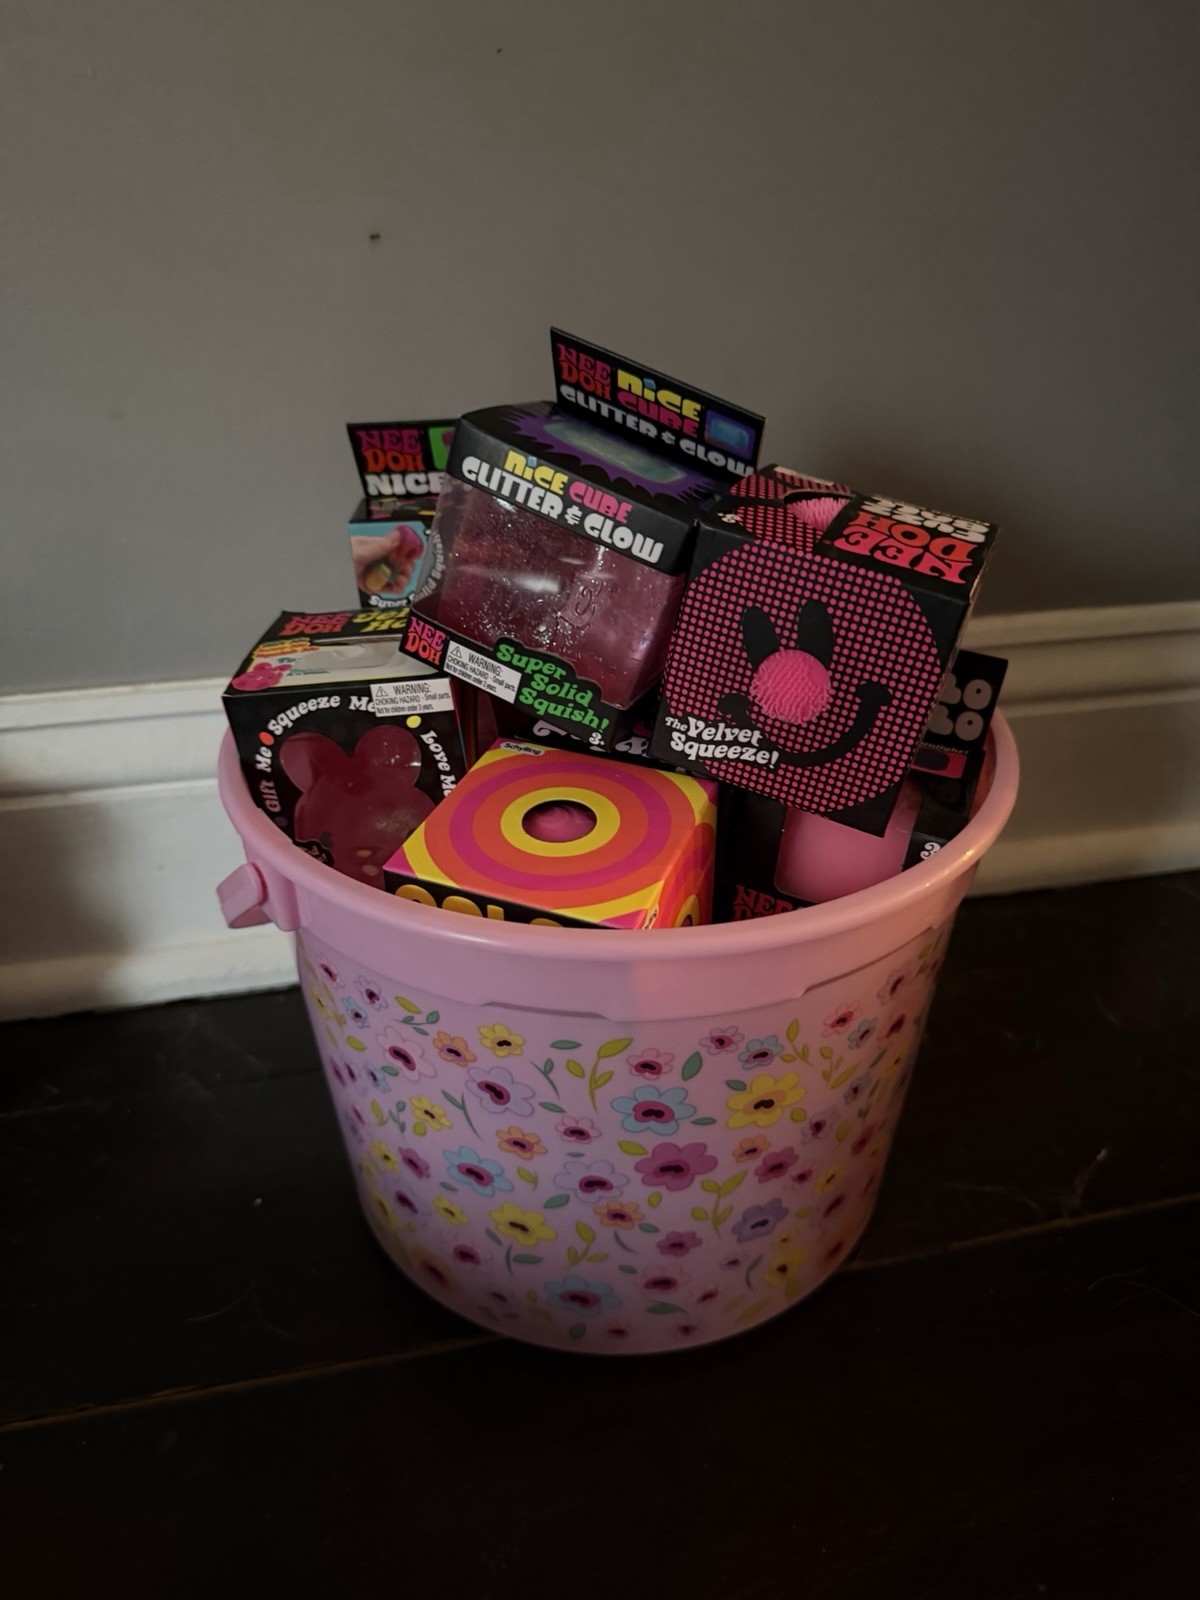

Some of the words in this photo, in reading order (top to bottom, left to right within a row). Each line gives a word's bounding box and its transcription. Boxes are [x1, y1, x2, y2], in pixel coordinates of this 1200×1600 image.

[556, 343, 612, 385] NEE
[560, 360, 613, 401] DOH
[559, 384, 658, 439] GLITTER
[660, 430, 677, 446] &
[679, 438, 754, 477] GLOW
[616, 390, 700, 438] CUBE
[356, 428, 422, 454] NEE
[361, 448, 426, 473] DOH
[461, 456, 564, 520] GLITTER
[564, 505, 582, 526] &
[583, 513, 664, 564] GLOW
[569, 480, 633, 524] CUBE
[833, 524, 974, 585] NEE
[850, 511, 978, 563] DOH
[278, 620, 345, 637] DOH
[287, 613, 351, 625] NEE
[409, 616, 447, 651] NEE
[404, 632, 443, 666] DOH
[496, 643, 567, 681] Super
[530, 672, 593, 707] Solid
[268, 695, 341, 737] Squeeze
[519, 687, 610, 733] Squish!
[588, 731, 606, 747] 3+
[665, 716, 688, 731] The
[687, 716, 763, 747] Velvet
[670, 731, 780, 769] Squeeze!
[255, 746, 273, 774] Me
[420, 730, 451, 772] Love
